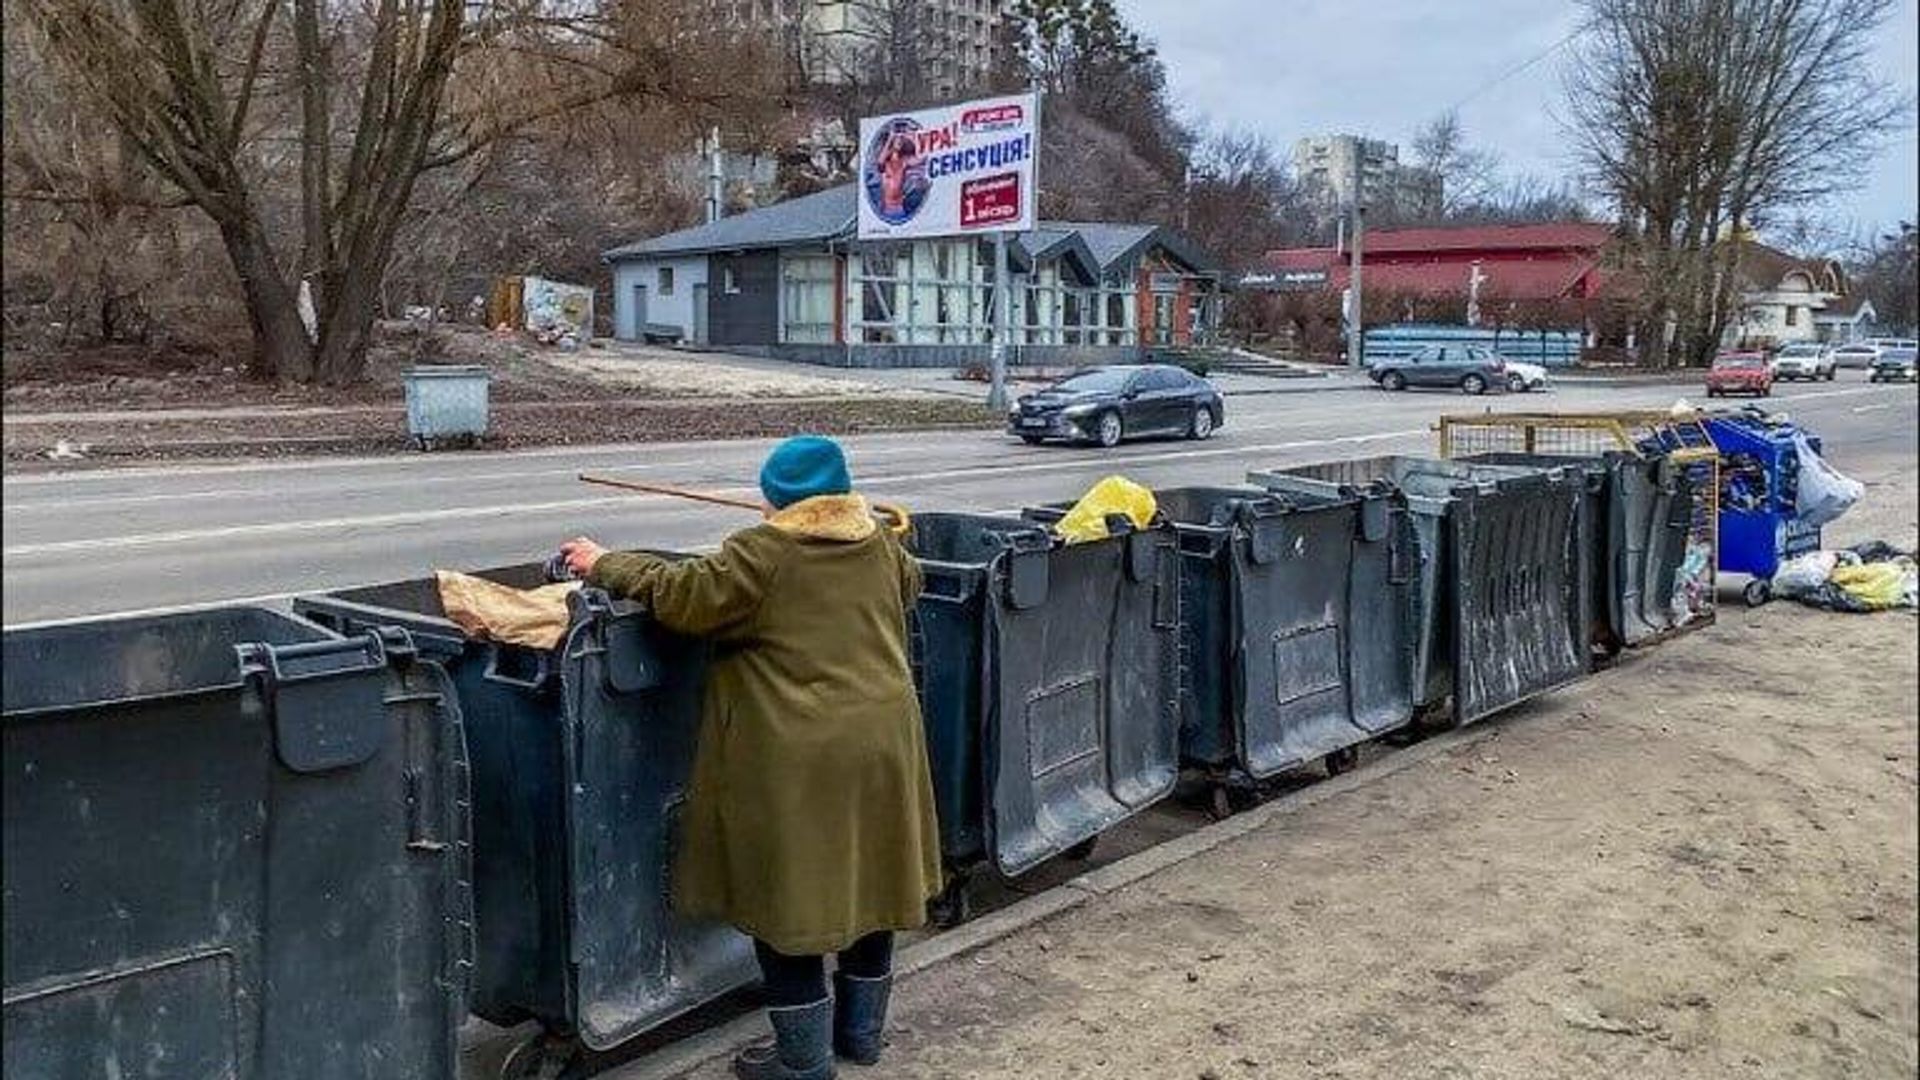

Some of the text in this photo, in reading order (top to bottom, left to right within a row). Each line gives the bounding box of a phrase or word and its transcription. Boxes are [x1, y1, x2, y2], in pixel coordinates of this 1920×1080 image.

[917, 121, 958, 153] УРА!
[928, 132, 1031, 179] СЕНСАЦІЯ!
[965, 197, 976, 221] 1
